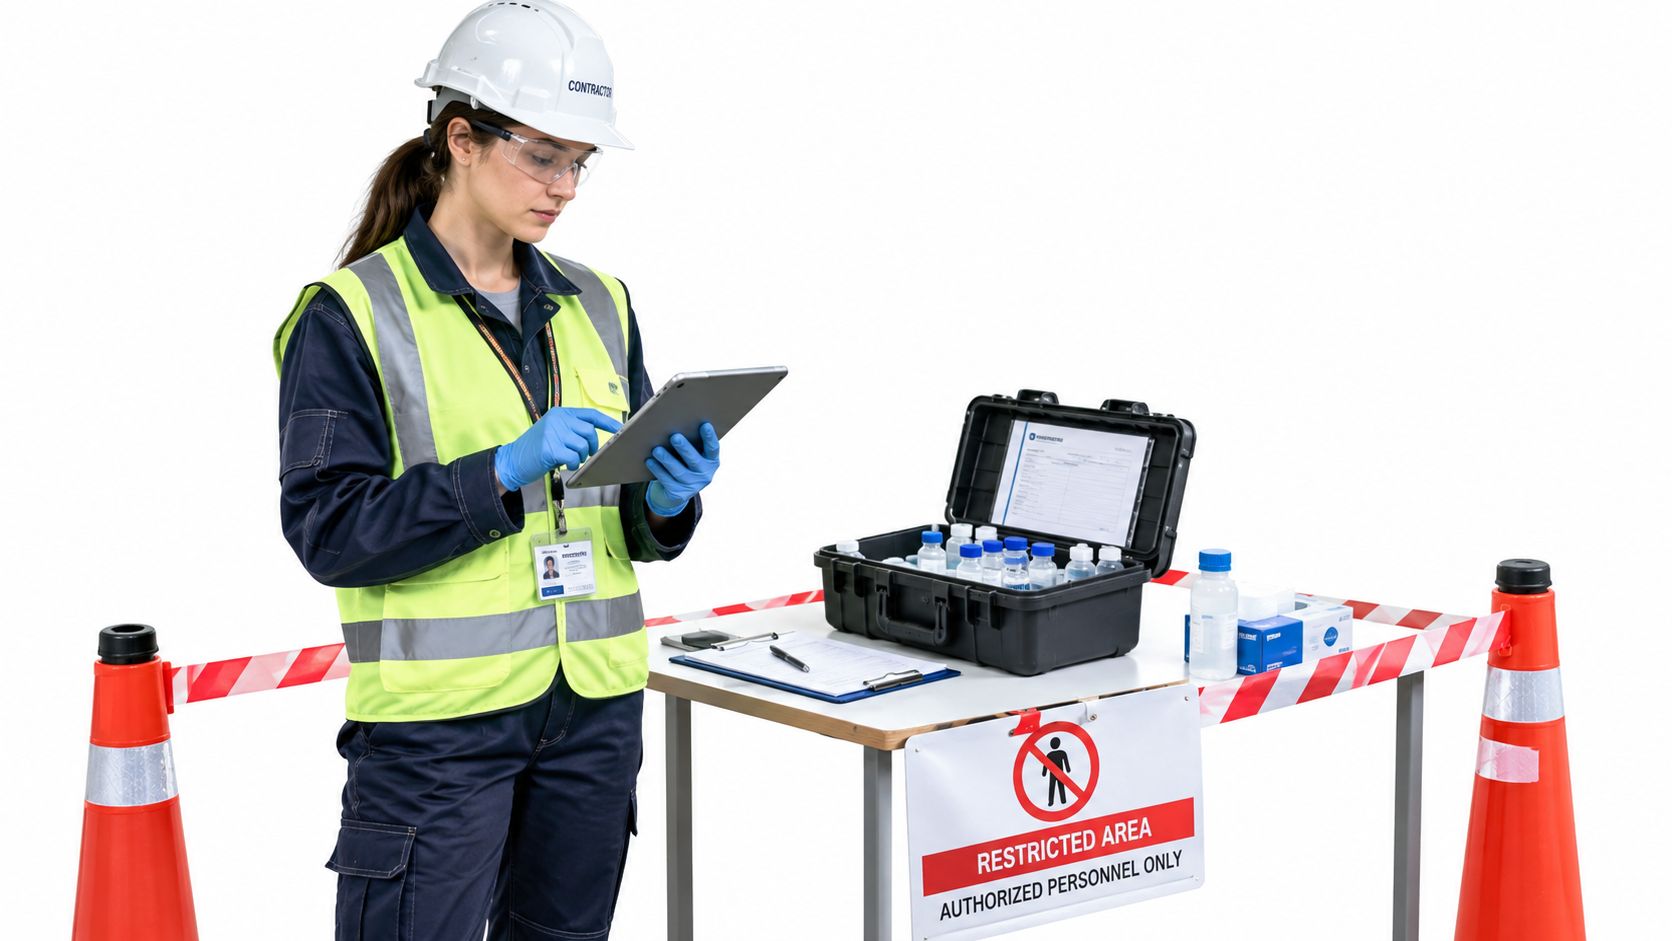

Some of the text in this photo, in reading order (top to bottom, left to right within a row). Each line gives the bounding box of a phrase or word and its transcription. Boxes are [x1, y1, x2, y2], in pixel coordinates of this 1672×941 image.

[568, 80, 612, 98] CONTRACTOR
[977, 816, 1152, 875] RESTRICTED AREA
[939, 849, 1183, 921] AUTHORIZED PERSONNEL ONLY
